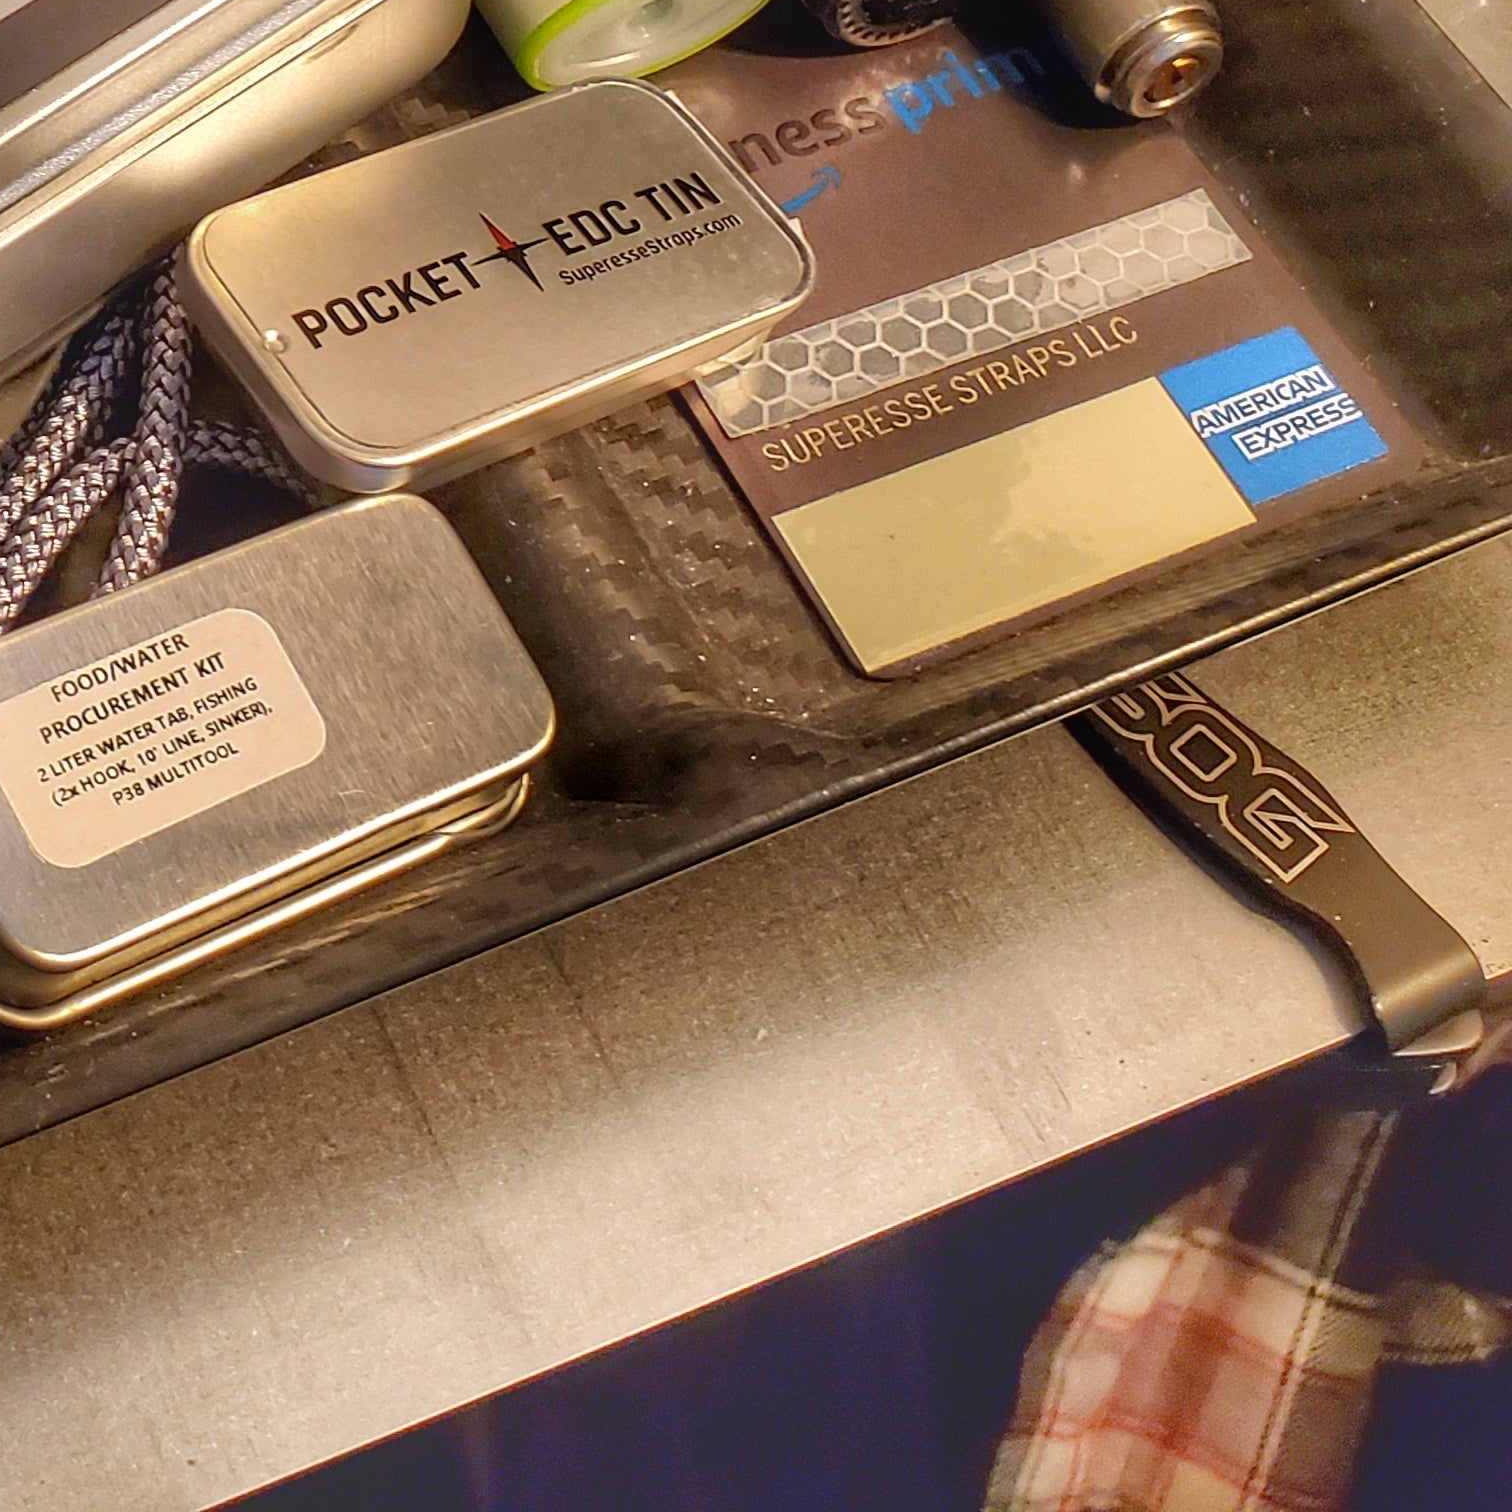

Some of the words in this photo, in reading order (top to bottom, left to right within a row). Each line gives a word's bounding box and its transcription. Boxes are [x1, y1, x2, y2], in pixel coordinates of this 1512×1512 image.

[728, 96, 888, 174] ness
[883, 44, 1046, 135] prim
[291, 251, 482, 350] POCKET
[542, 200, 642, 257] EDC
[635, 171, 723, 224] TIN
[558, 212, 742, 287] SuperesseStraps.com
[761, 384, 954, 473] SUPERESSE
[955, 338, 1079, 413] STRAPS
[1079, 315, 1140, 362] LLC
[1194, 369, 1329, 435] AMERICAN
[1240, 397, 1359, 458] EXPRESS
[39, 667, 191, 744] PROCUREMENT
[194, 652, 225, 679] KIT
[50, 633, 190, 703] FOOD/WATER
[37, 767, 49, 782] 2
[50, 748, 97, 778] LITER
[96, 721, 157, 756] WATER
[158, 706, 195, 734] TAB,
[193, 678, 259, 714] FISHING
[51, 784, 81, 807] (2x
[79, 762, 137, 793] HOOK,
[164, 726, 206, 756] LINE,
[206, 700, 274, 738] SINKER),
[111, 782, 146, 806] P38
[146, 741, 240, 791] MULTITOOL
